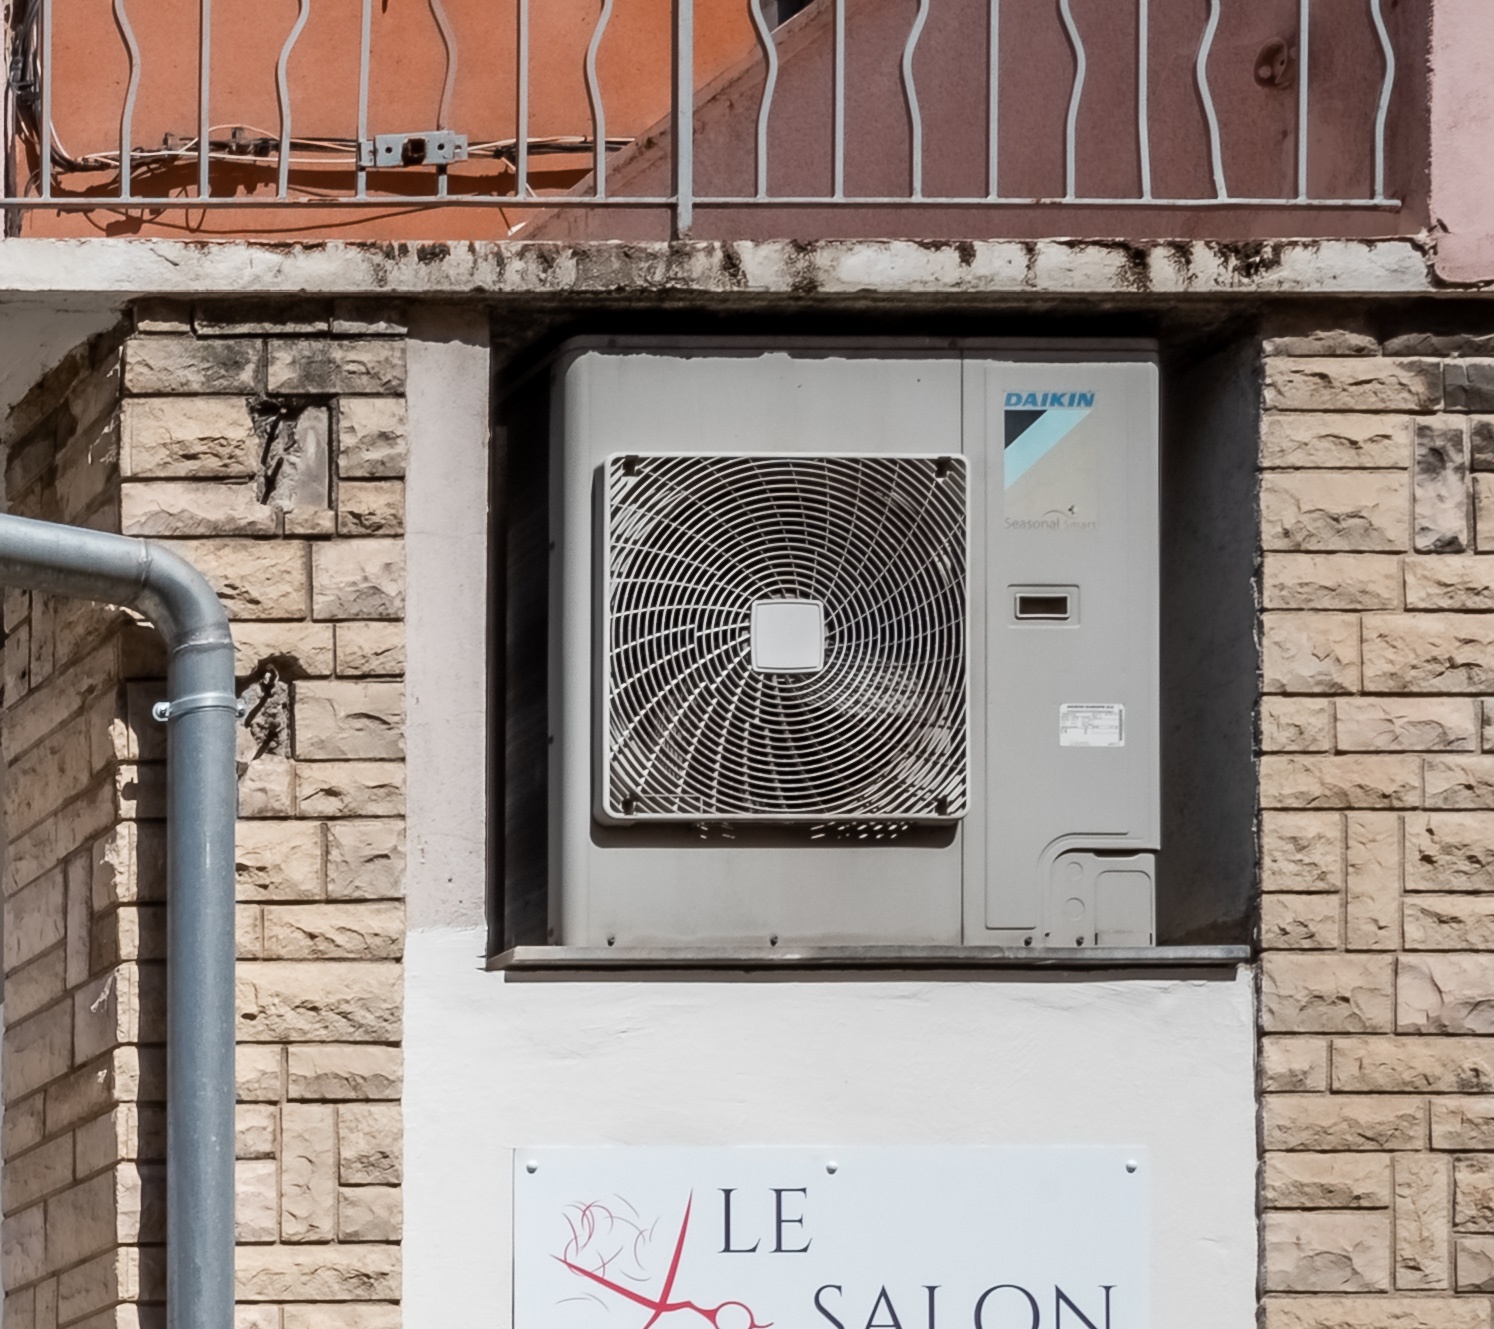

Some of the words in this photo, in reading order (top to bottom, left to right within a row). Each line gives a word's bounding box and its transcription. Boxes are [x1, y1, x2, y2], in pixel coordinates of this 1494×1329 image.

[1004, 392, 1096, 408] DAIKIN
[1004, 517, 1060, 530] Seasonal
[1064, 518, 1096, 530] Smart
[717, 1187, 813, 1254] LE
